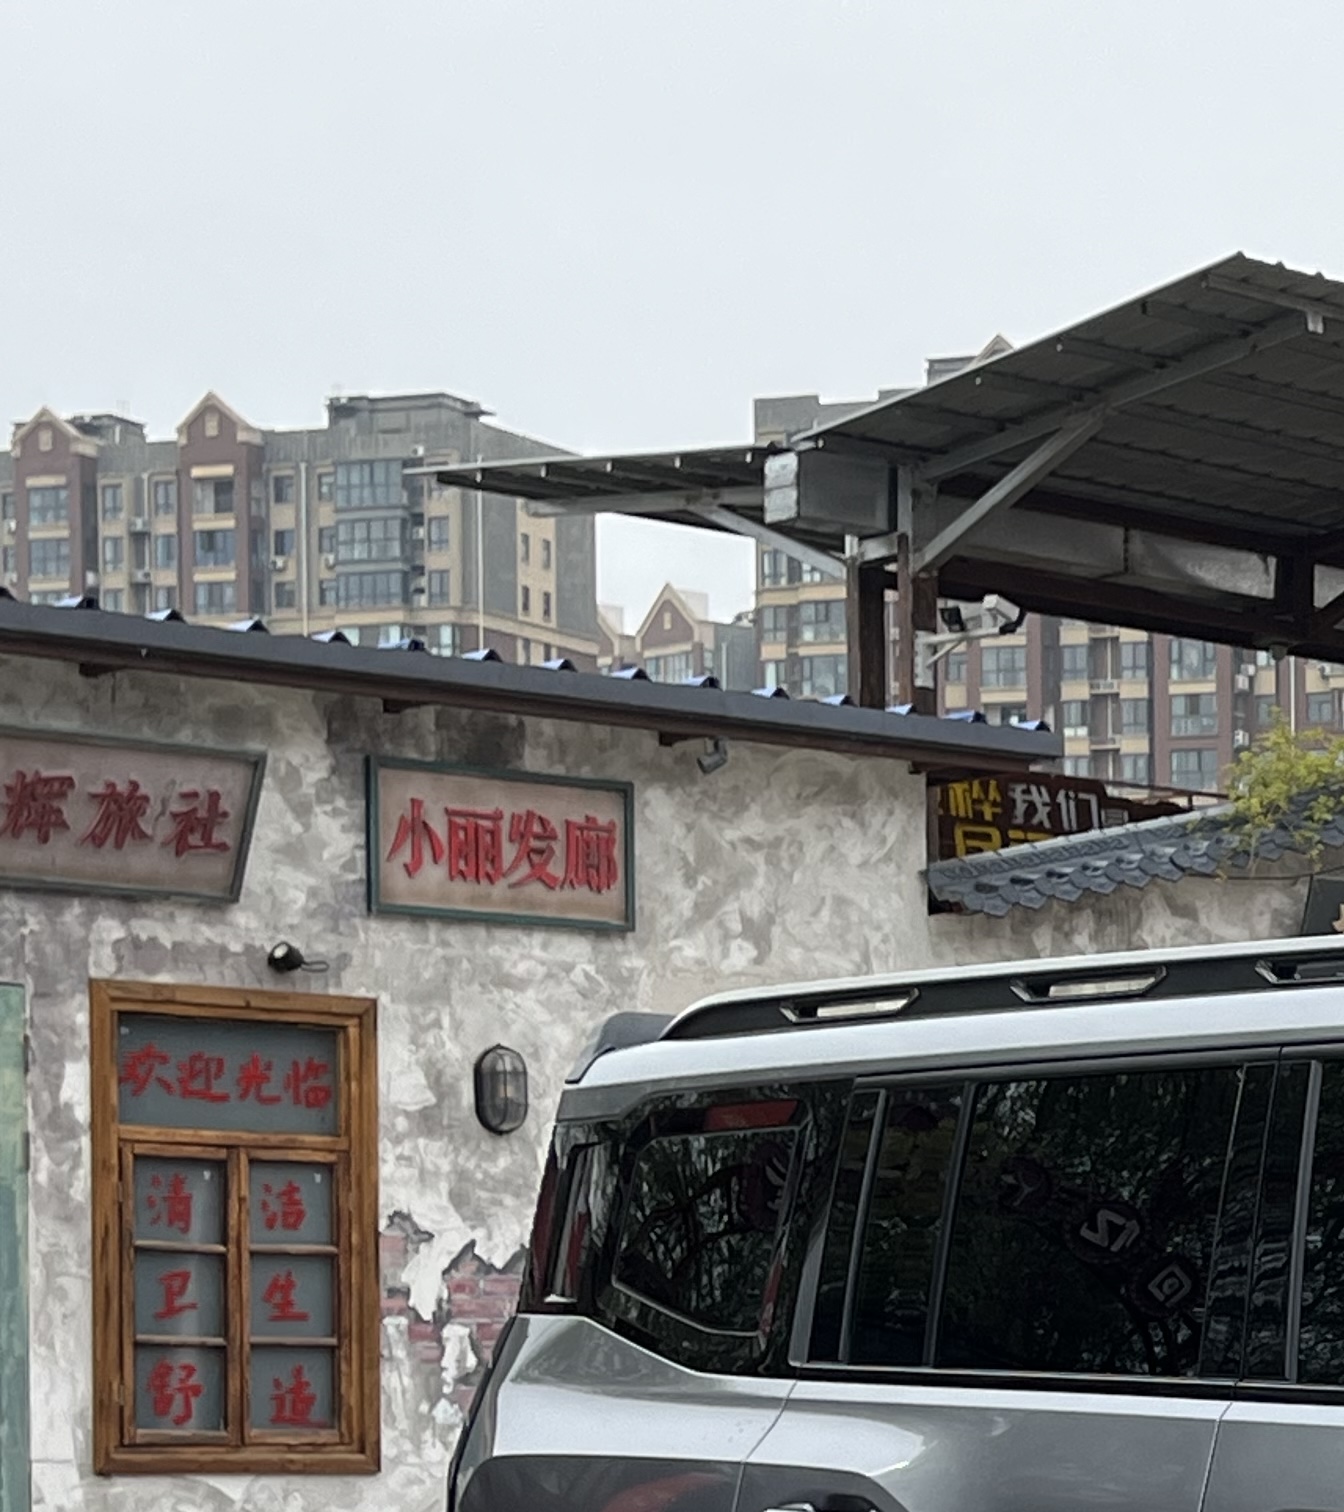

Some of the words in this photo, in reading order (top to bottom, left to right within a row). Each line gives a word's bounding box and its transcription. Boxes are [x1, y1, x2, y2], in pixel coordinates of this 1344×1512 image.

[0, 770, 231, 857] 辉旅社
[386, 797, 618, 894] 小丽发廊
[118, 1042, 334, 1109] 欢迎光临
